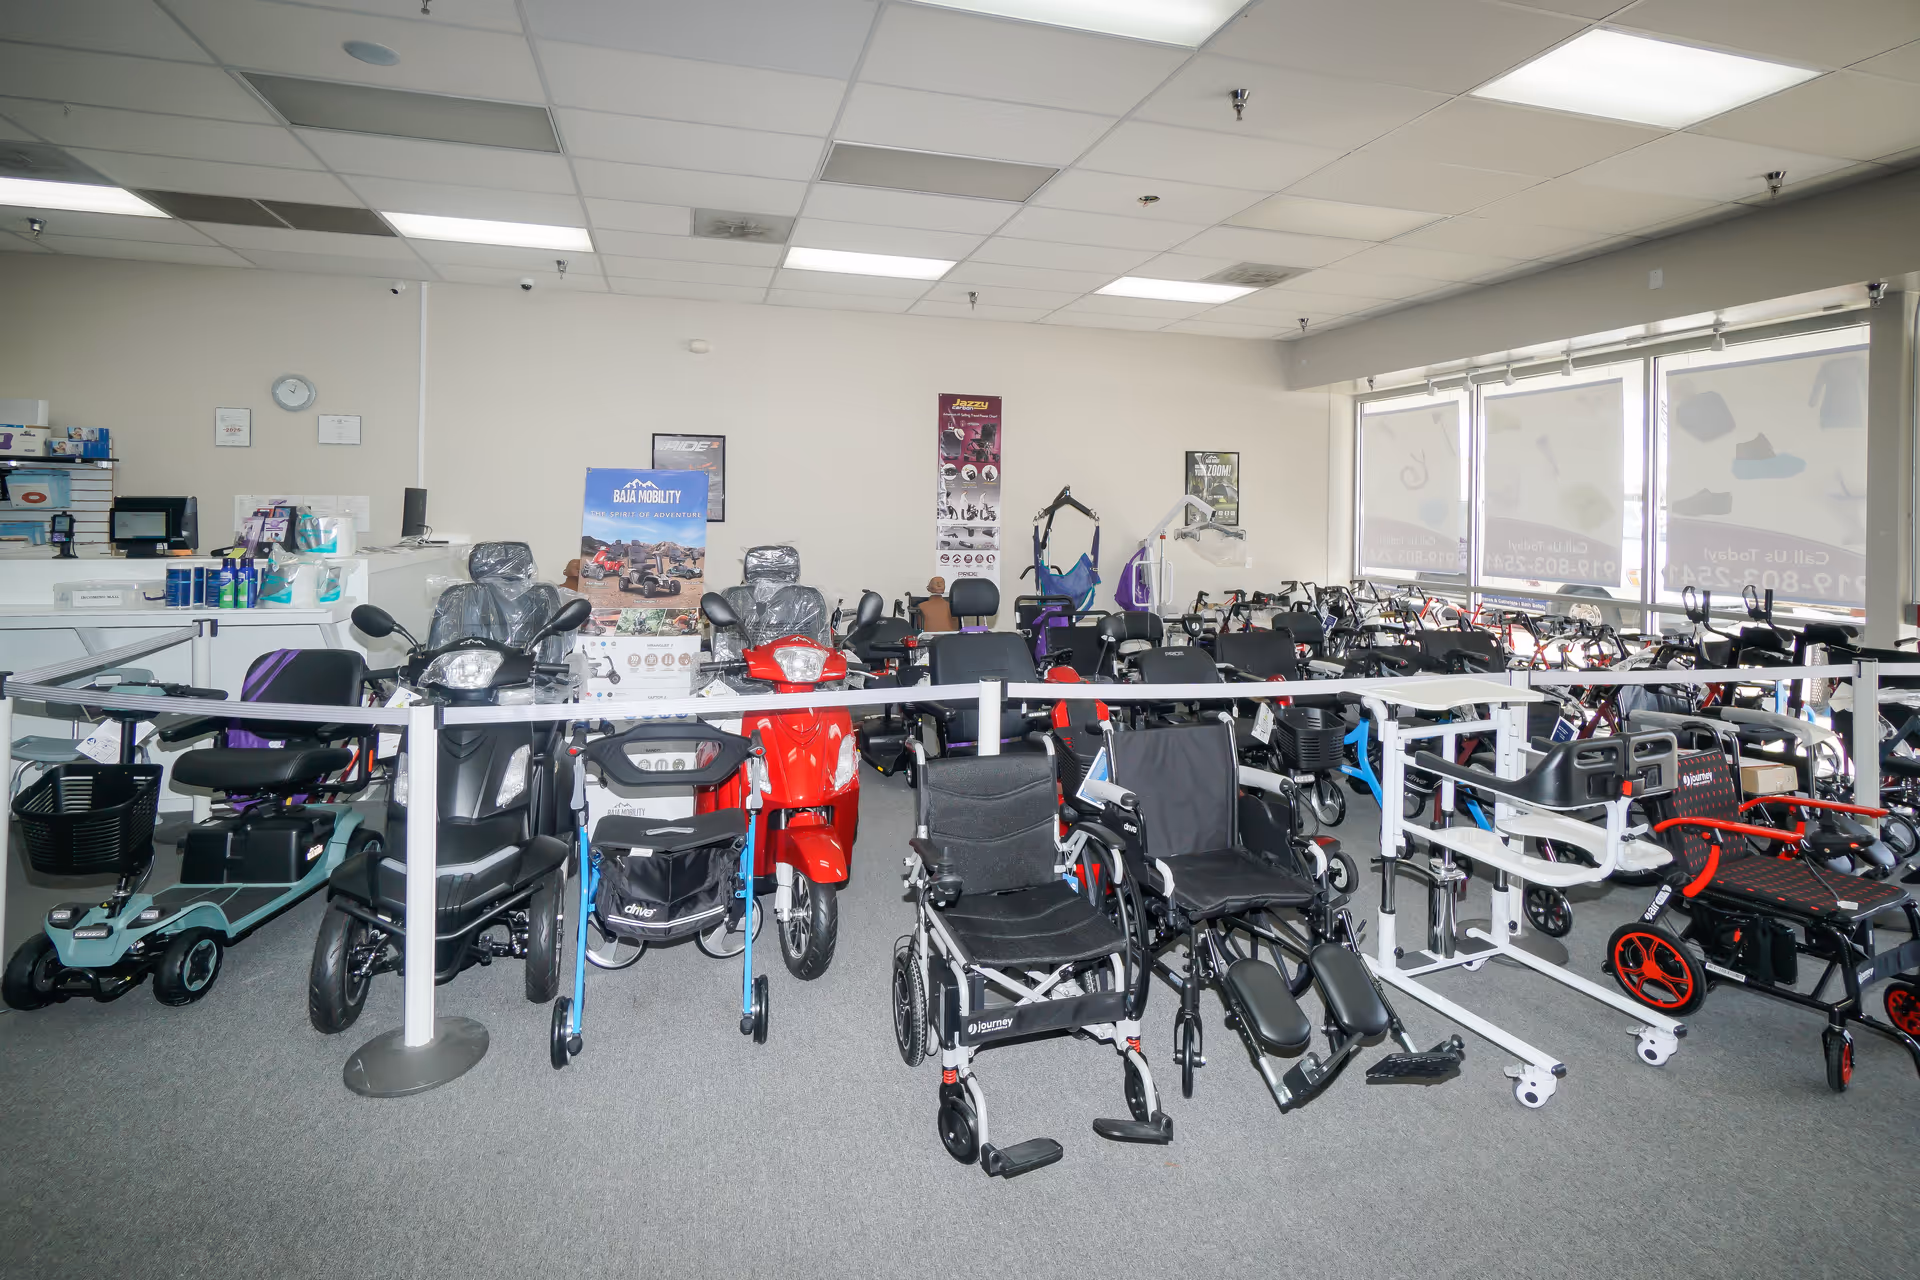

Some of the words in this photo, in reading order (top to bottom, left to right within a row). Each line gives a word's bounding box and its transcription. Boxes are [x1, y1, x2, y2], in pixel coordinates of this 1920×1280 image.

[952, 398, 989, 410] Jazzy
[1207, 464, 1232, 477] ZOOM!
[613, 489, 636, 503] BAJA
[638, 489, 682, 504] MOBILITY
[590, 510, 606, 518] THE
[653, 511, 702, 519] ADVENTURE
[1690, 771, 1713, 787] journey
[621, 807, 646, 817] MOBILITY
[1123, 822, 1138, 834] drive
[624, 903, 657, 918] drive
[977, 1017, 1014, 1033] journey
